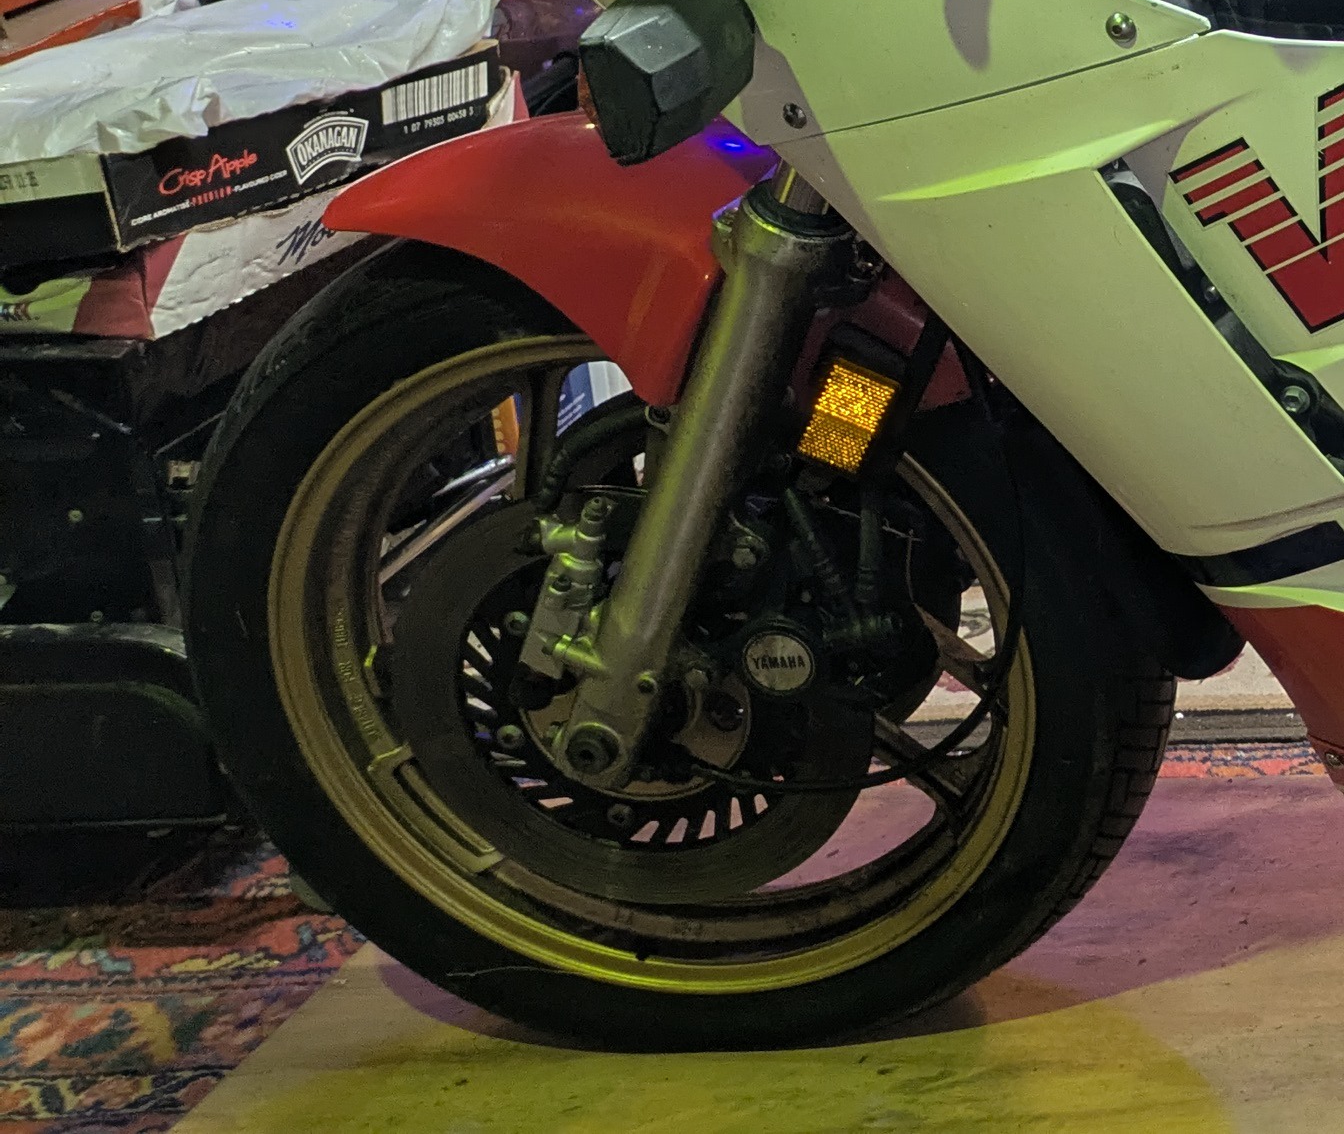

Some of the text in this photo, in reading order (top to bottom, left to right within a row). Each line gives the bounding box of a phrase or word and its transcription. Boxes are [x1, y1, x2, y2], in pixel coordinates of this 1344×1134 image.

[296, 123, 358, 166] OKANAGAN
[158, 150, 258, 196] Crisp Apple
[753, 654, 806, 670] YAMAHA
